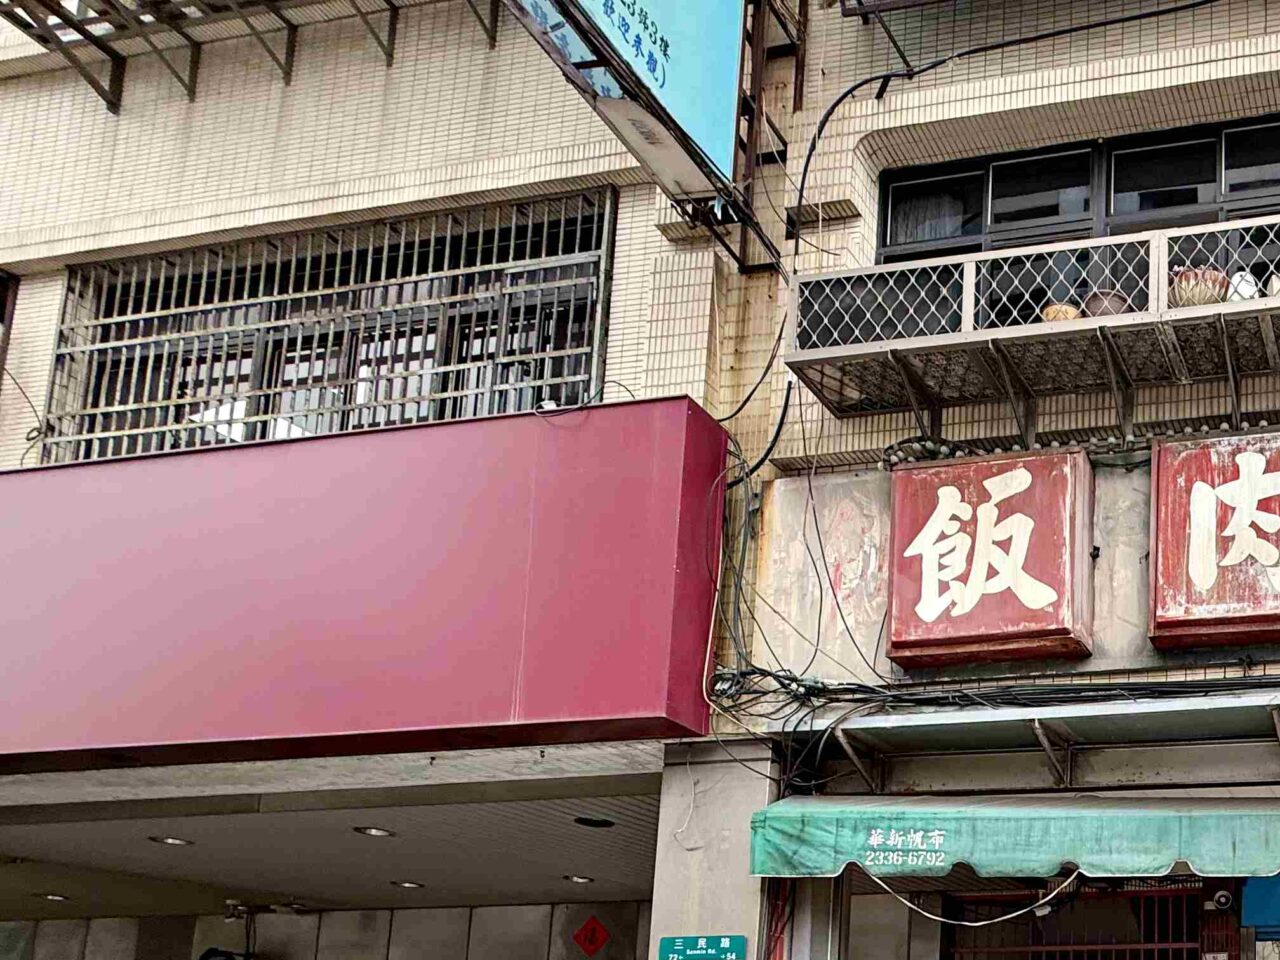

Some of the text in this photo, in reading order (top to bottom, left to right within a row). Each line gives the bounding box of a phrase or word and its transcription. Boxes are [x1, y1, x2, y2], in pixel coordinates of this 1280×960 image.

[867, 828, 947, 850] 華新帆布
[865, 851, 946, 866] 2336-6792
[673, 937, 731, 950] 三民路
